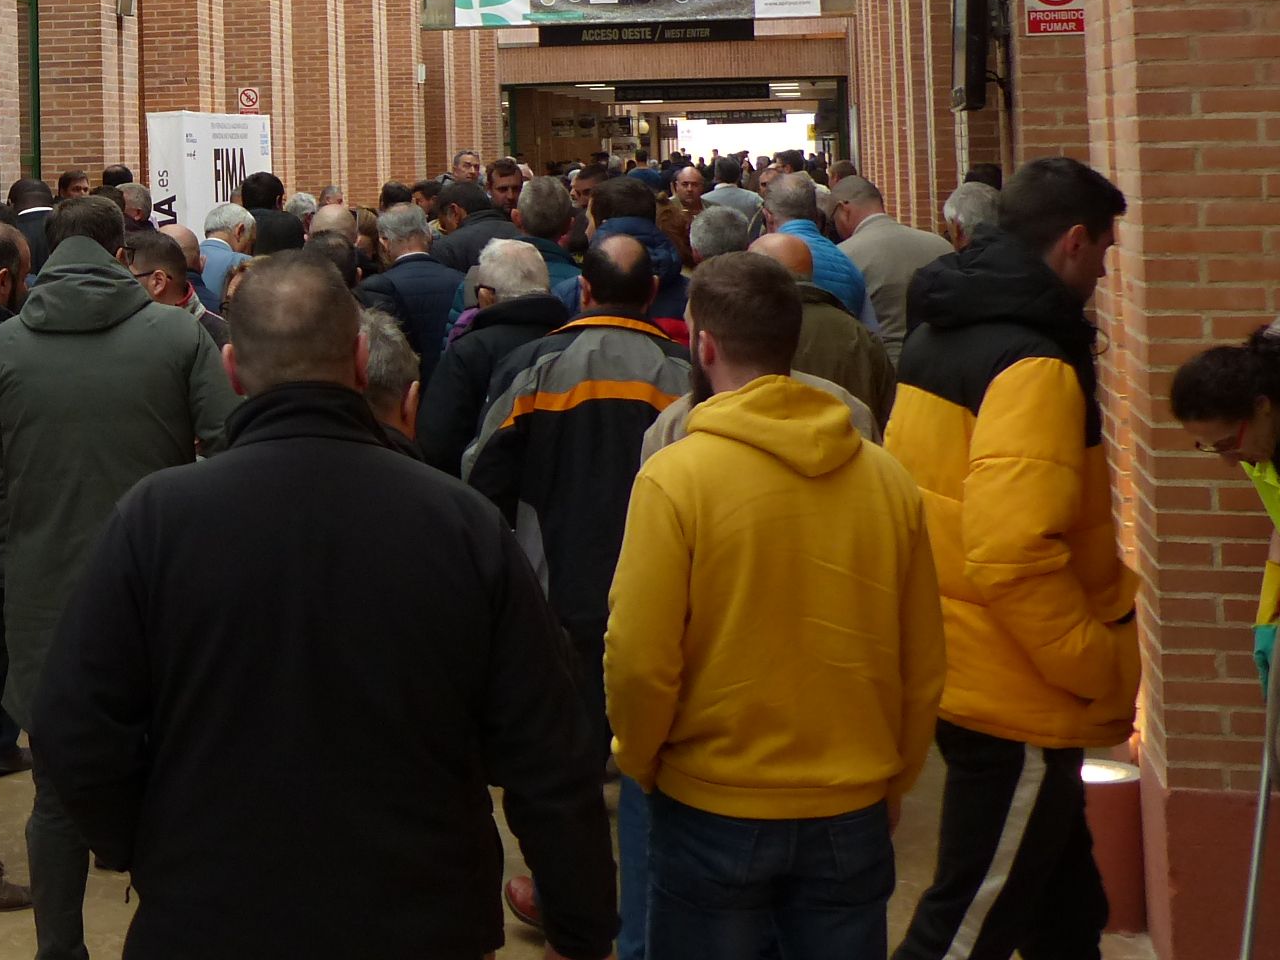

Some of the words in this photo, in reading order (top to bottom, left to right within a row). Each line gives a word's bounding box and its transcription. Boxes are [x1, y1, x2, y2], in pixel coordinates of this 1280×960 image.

[1030, 11, 1085, 20] PROHIBIDO
[1040, 22, 1076, 31] FUMAR
[581, 28, 619, 40] ACCESO
[621, 27, 652, 39] OESTE
[664, 28, 686, 38] WEST
[687, 27, 711, 37] ENTER
[214, 148, 247, 202] FIMA
